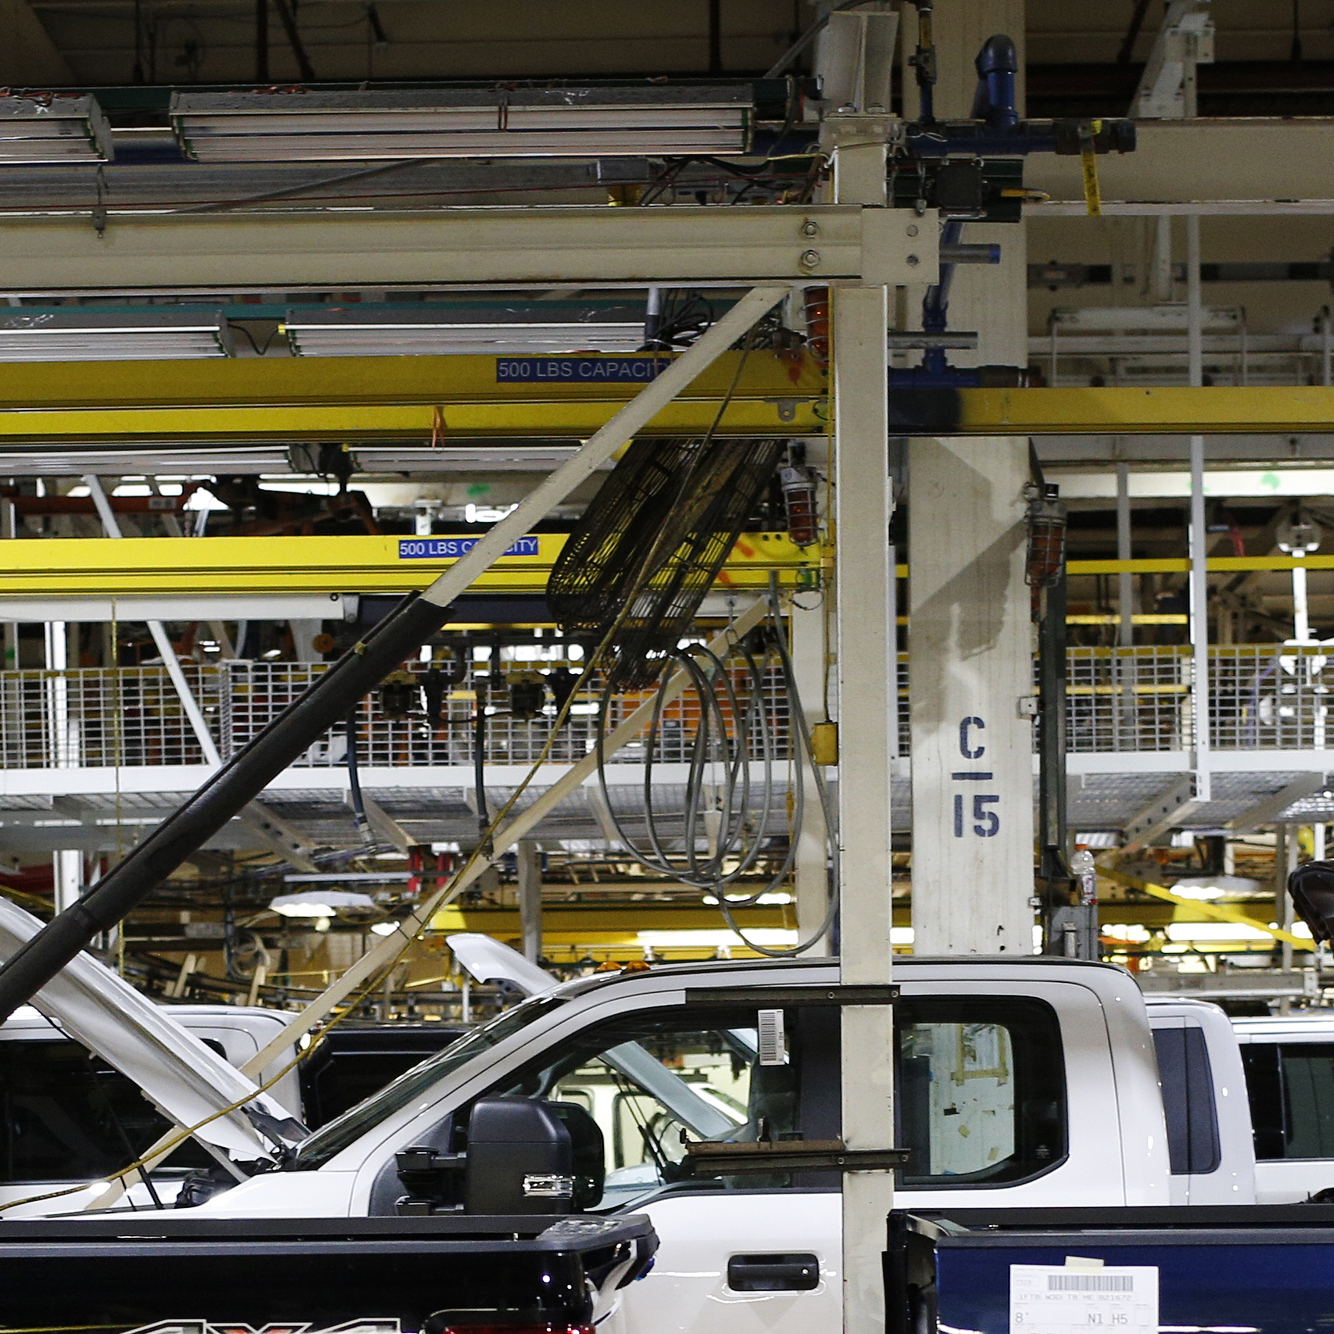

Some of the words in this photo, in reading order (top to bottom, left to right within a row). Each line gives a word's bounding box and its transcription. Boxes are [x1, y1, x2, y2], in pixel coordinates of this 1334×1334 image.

[498, 362, 531, 377] 500
[536, 362, 573, 377] LBS
[578, 362, 667, 377] CAPACIT
[400, 542, 425, 555] 500
[429, 541, 458, 555] LBS
[461, 539, 537, 554] CITY
[959, 716, 985, 759] C
[954, 794, 1000, 837] 15
[1088, 1313, 1103, 1325] N1
[1112, 1314, 1128, 1325] H5
